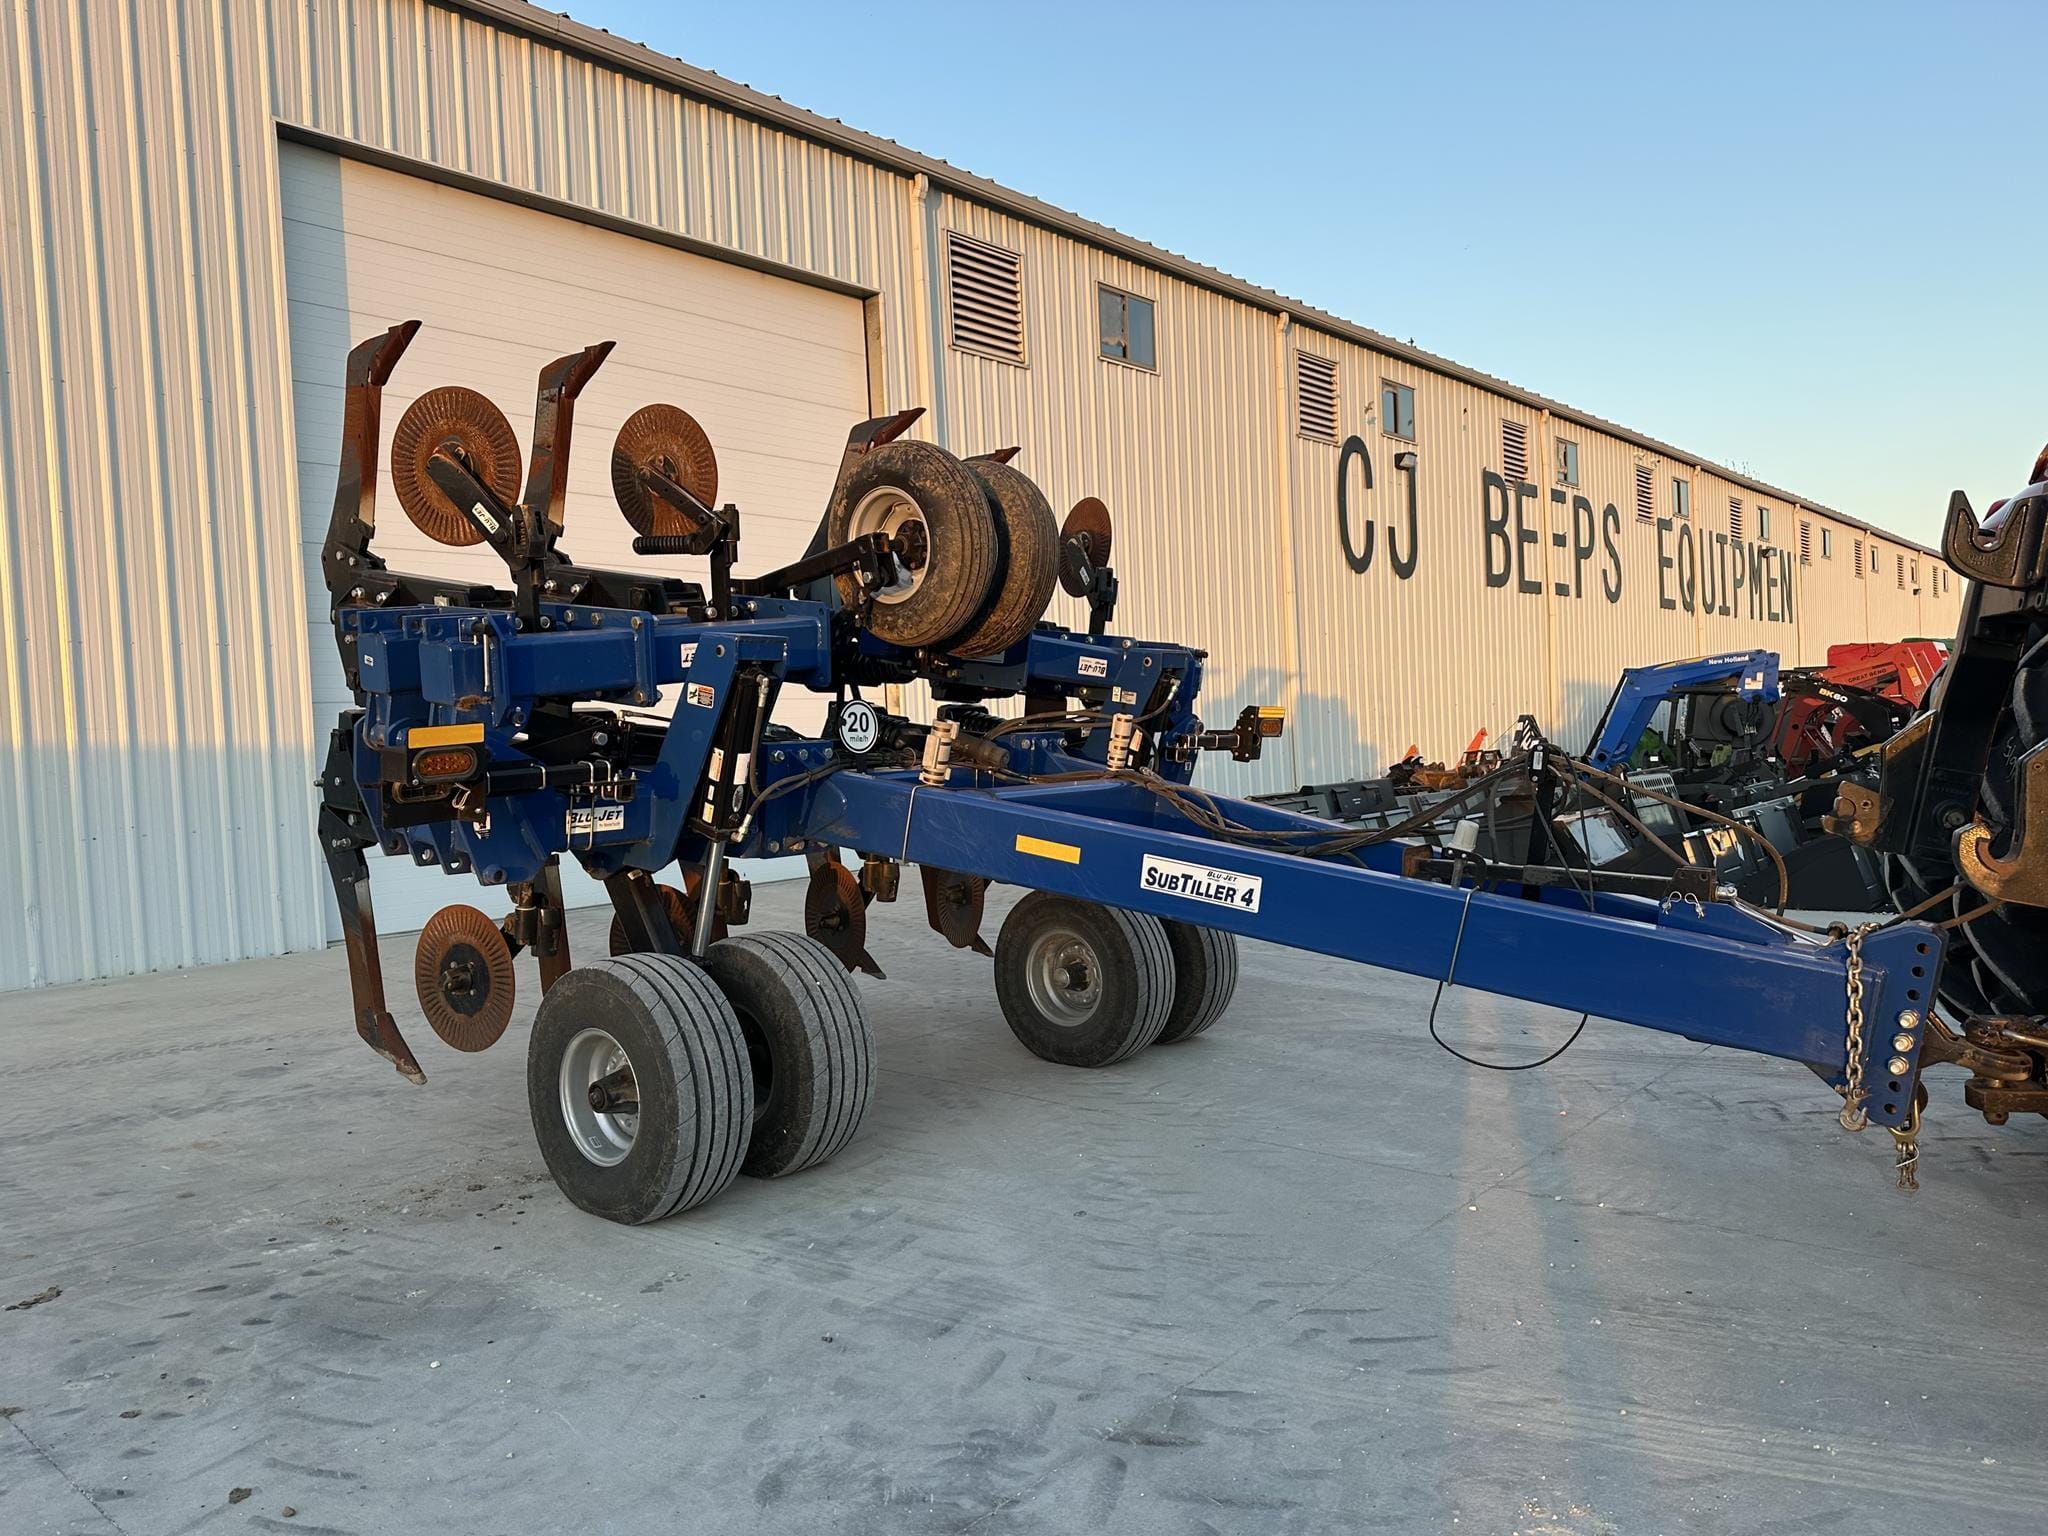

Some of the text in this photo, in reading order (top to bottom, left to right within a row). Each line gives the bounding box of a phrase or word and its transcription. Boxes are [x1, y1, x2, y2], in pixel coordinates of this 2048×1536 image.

[1482, 466, 1622, 604] BEEPS
[1656, 517, 1804, 624] EQUIPMEN
[1724, 654, 1749, 664] Holland
[1079, 663, 1106, 675] BLU-JET
[1847, 673, 1868, 683] GREAT
[847, 711, 870, 733] 20
[567, 810, 622, 825] BLU-JET
[1206, 870, 1238, 882] BLU-JET
[1240, 887, 1255, 907] 4
